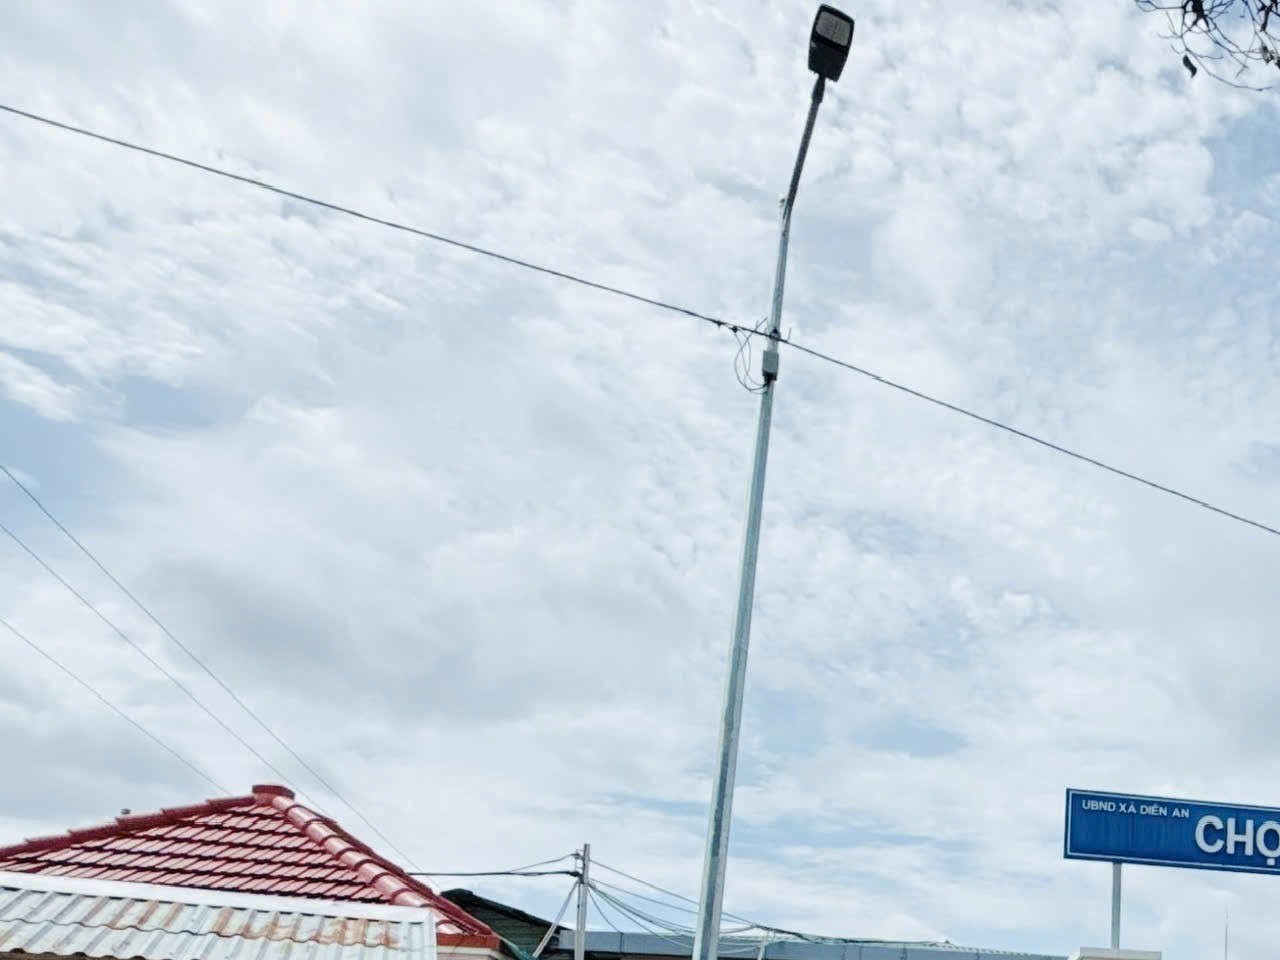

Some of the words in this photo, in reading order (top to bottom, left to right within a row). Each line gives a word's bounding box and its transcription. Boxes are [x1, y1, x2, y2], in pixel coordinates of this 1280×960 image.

[1082, 800, 1116, 812] UBND
[1119, 801, 1137, 814] XÃ
[1172, 808, 1189, 818] AN
